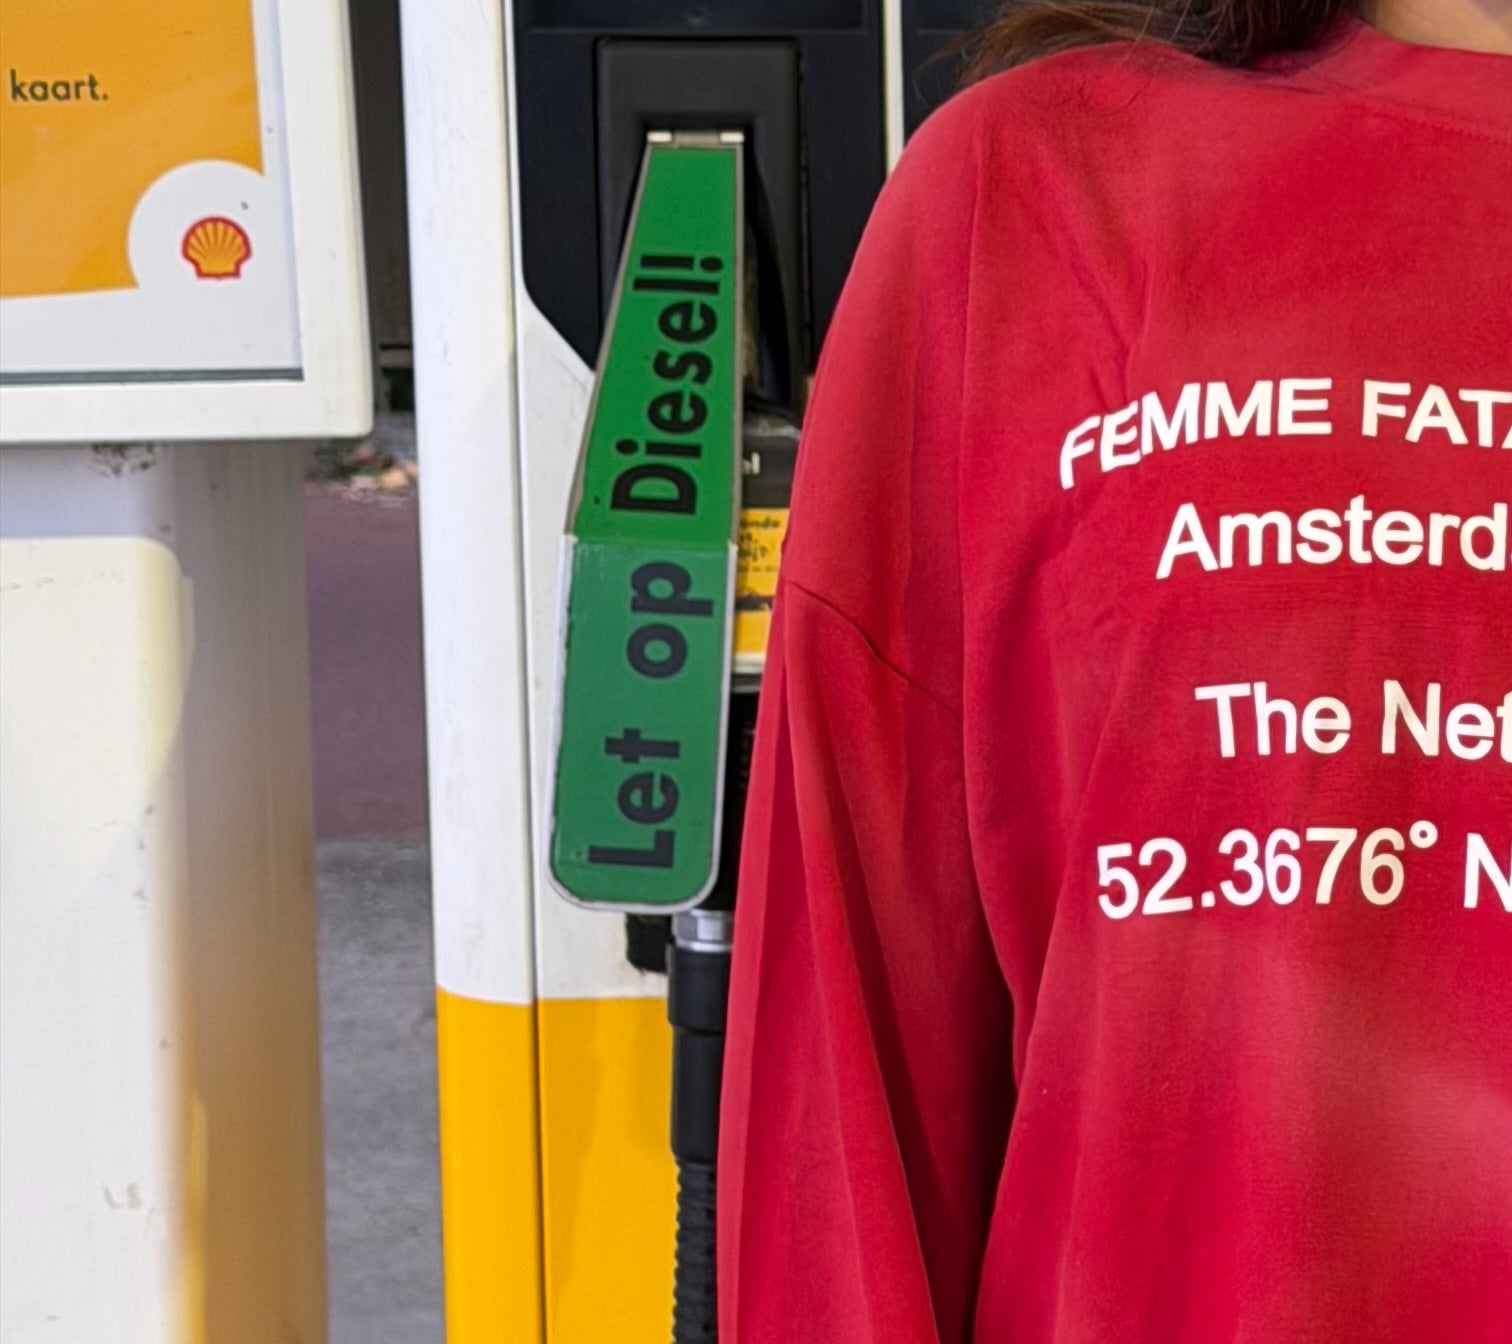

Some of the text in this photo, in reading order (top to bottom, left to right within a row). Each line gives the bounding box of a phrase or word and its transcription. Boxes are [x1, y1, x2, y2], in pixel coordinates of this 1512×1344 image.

[10, 68, 109, 101] kaart.
[1059, 377, 1333, 490] FEMME
[588, 254, 724, 870] Let op Diesel!
[1194, 681, 1352, 758] The
[1097, 820, 1438, 920] 52.3676°
